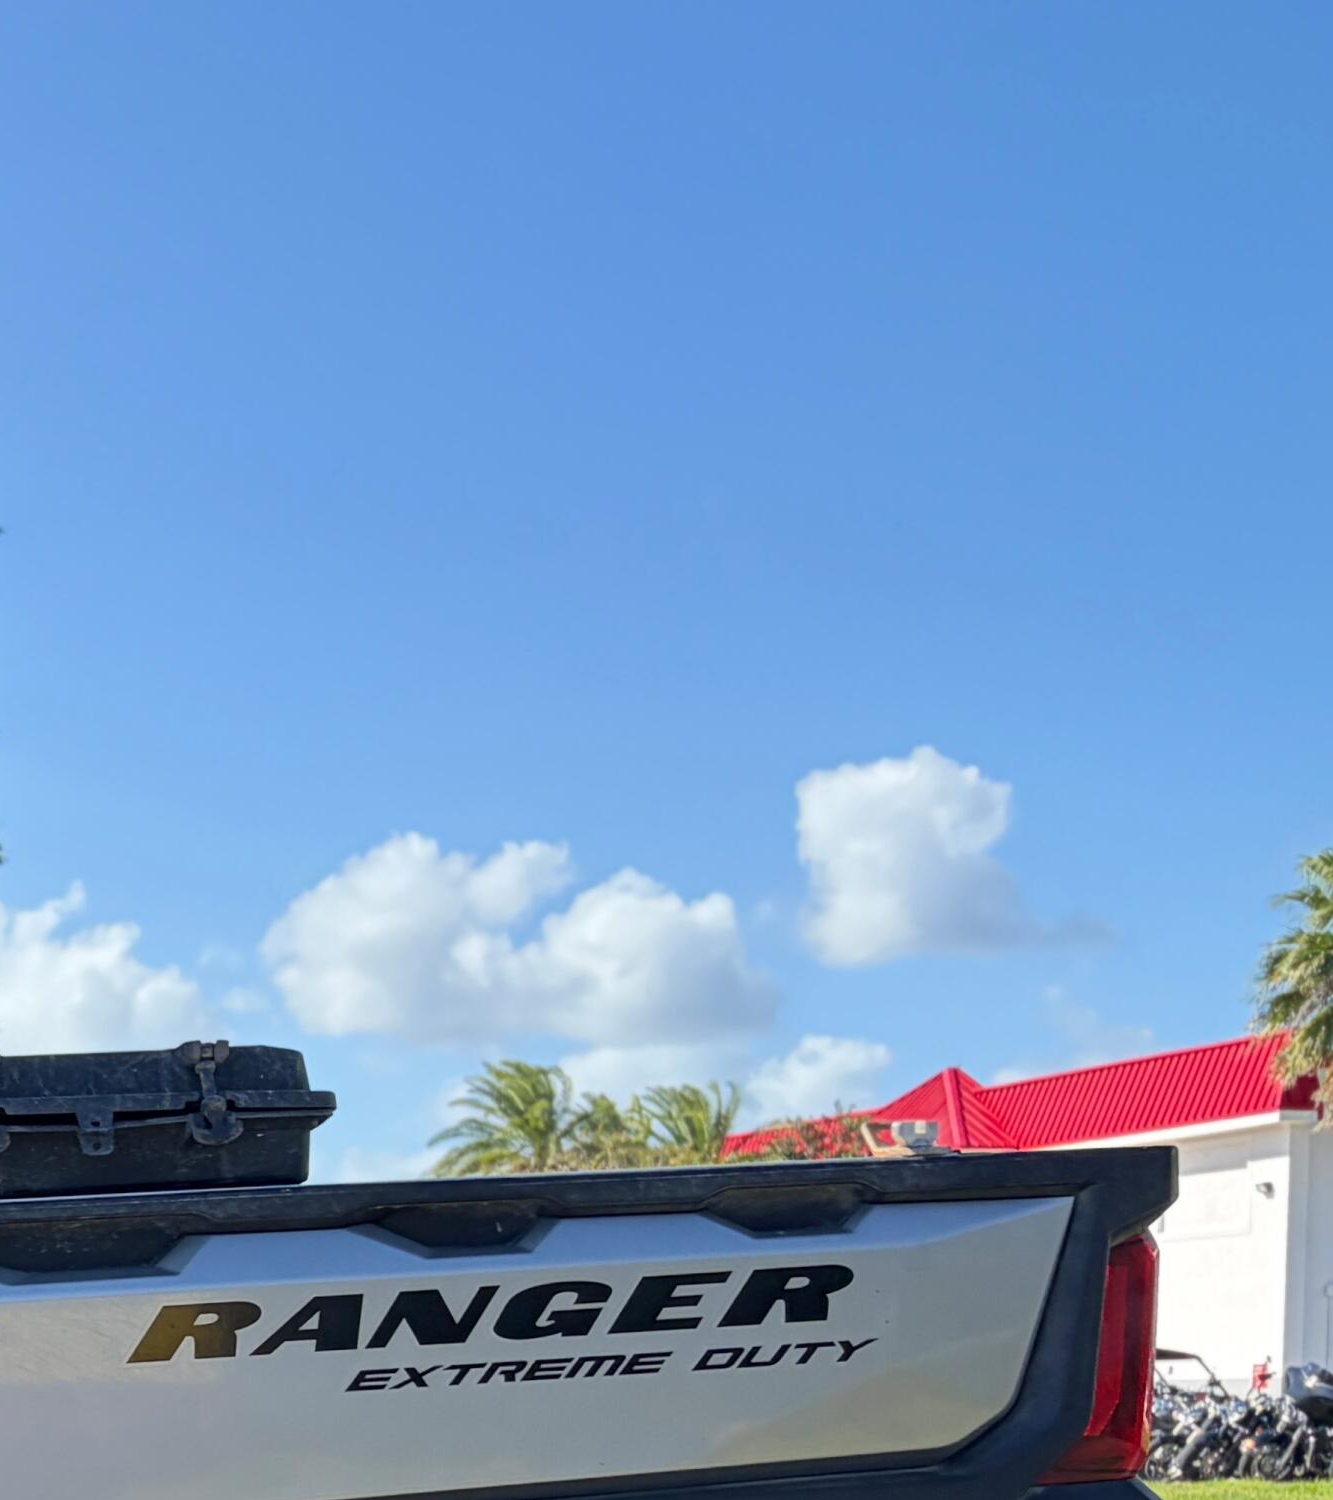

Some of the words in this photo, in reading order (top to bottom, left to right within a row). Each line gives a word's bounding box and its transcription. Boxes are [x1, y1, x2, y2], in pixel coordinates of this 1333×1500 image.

[126, 1263, 855, 1364] RANGER
[345, 1351, 673, 1392] EXTREME
[691, 1338, 879, 1372] DUTY
